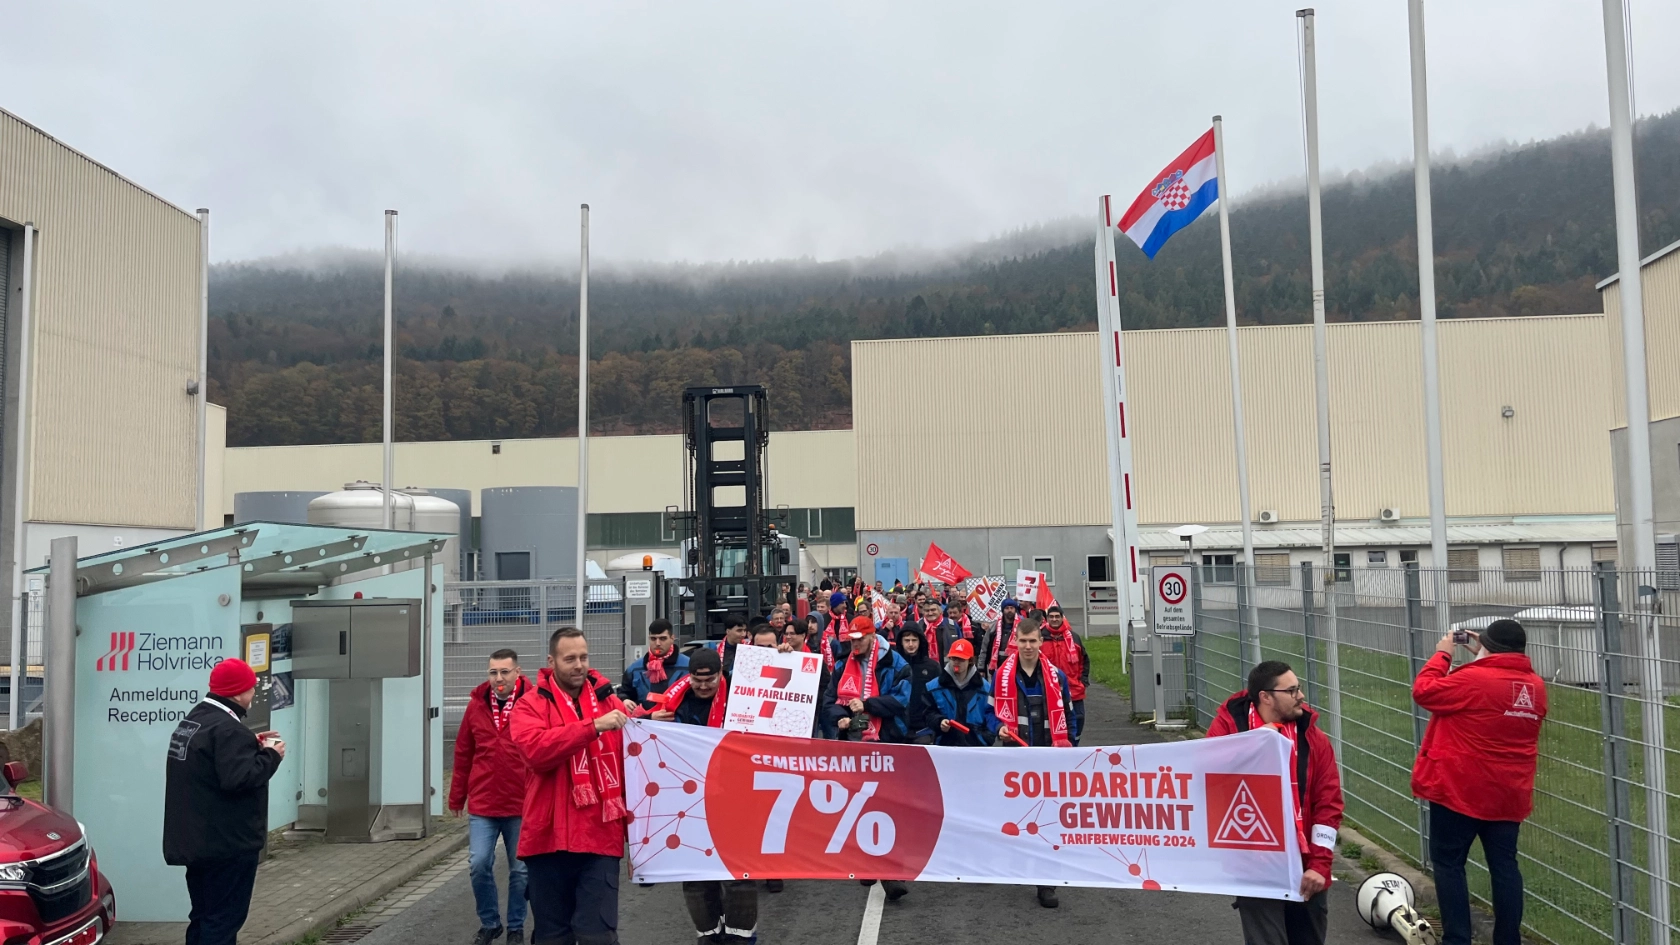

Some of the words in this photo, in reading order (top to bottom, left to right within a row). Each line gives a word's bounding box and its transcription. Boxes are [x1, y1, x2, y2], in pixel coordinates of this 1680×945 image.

[1165, 582, 1181, 596] 30
[1156, 623, 1192, 632] Betriebsgelände
[139, 633, 223, 650] Ziemann
[110, 687, 198, 704] Anmeldung
[734, 686, 755, 697] ZUM
[757, 688, 813, 704] FAIRLIEBEN
[759, 665, 792, 719] 7
[108, 707, 186, 725] Reception
[751, 754, 856, 772] GEMEINSAM
[861, 751, 895, 773] FÜR
[1003, 765, 1193, 799] SOLIDARITÄT
[753, 771, 896, 856] 7%
[1059, 802, 1194, 831] GEWINNT
[1060, 833, 1161, 847] TARIFBEWEGUNG
[1163, 834, 1196, 848] 2024
